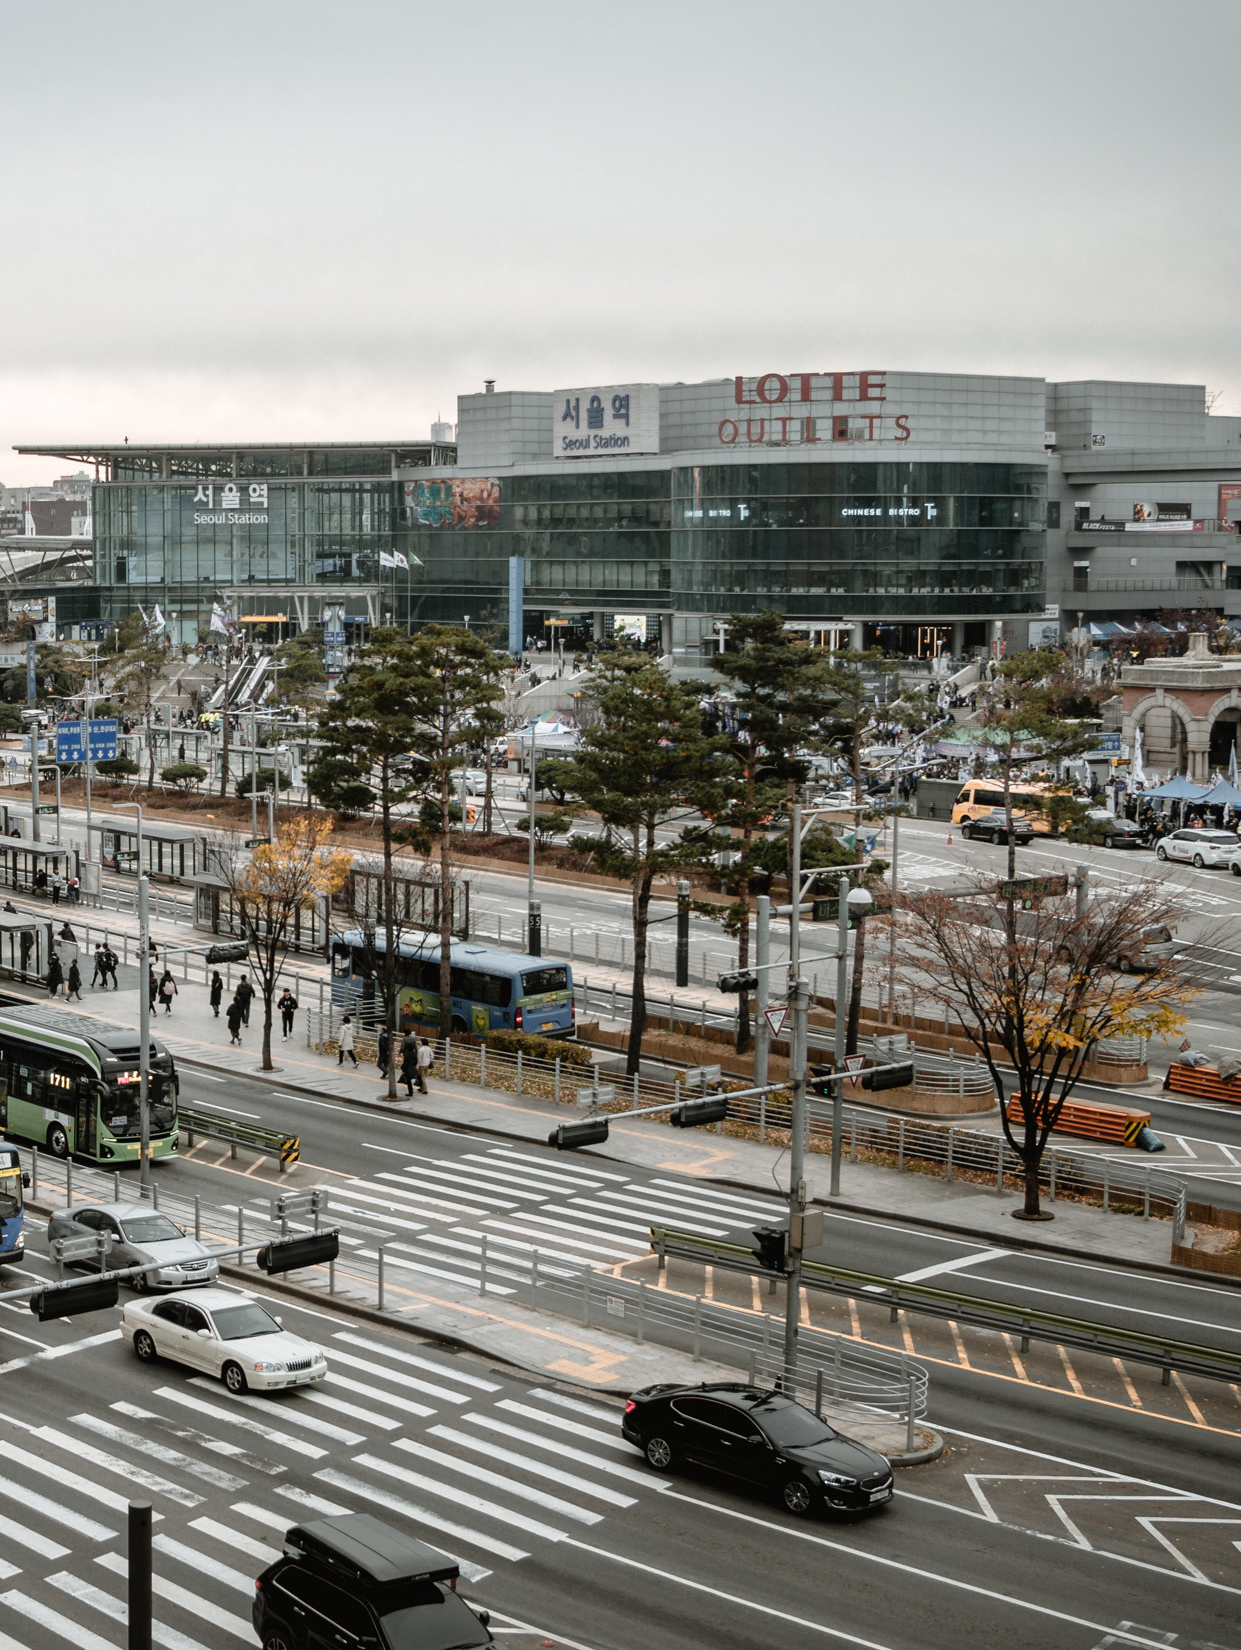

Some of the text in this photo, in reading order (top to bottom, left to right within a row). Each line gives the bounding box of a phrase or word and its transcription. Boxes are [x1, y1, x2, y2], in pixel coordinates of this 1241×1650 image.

[735, 372, 887, 404] LOTTE
[562, 394, 630, 429] 서울역
[718, 415, 911, 444] OUTLETS
[562, 433, 629, 450] Seoul Station
[193, 483, 268, 509] 서울역
[194, 513, 268, 523] Seoul Station
[841, 508, 882, 516] CHINESE
[888, 508, 920, 516] BISTRO
[49, 1072, 70, 1089] 1711
